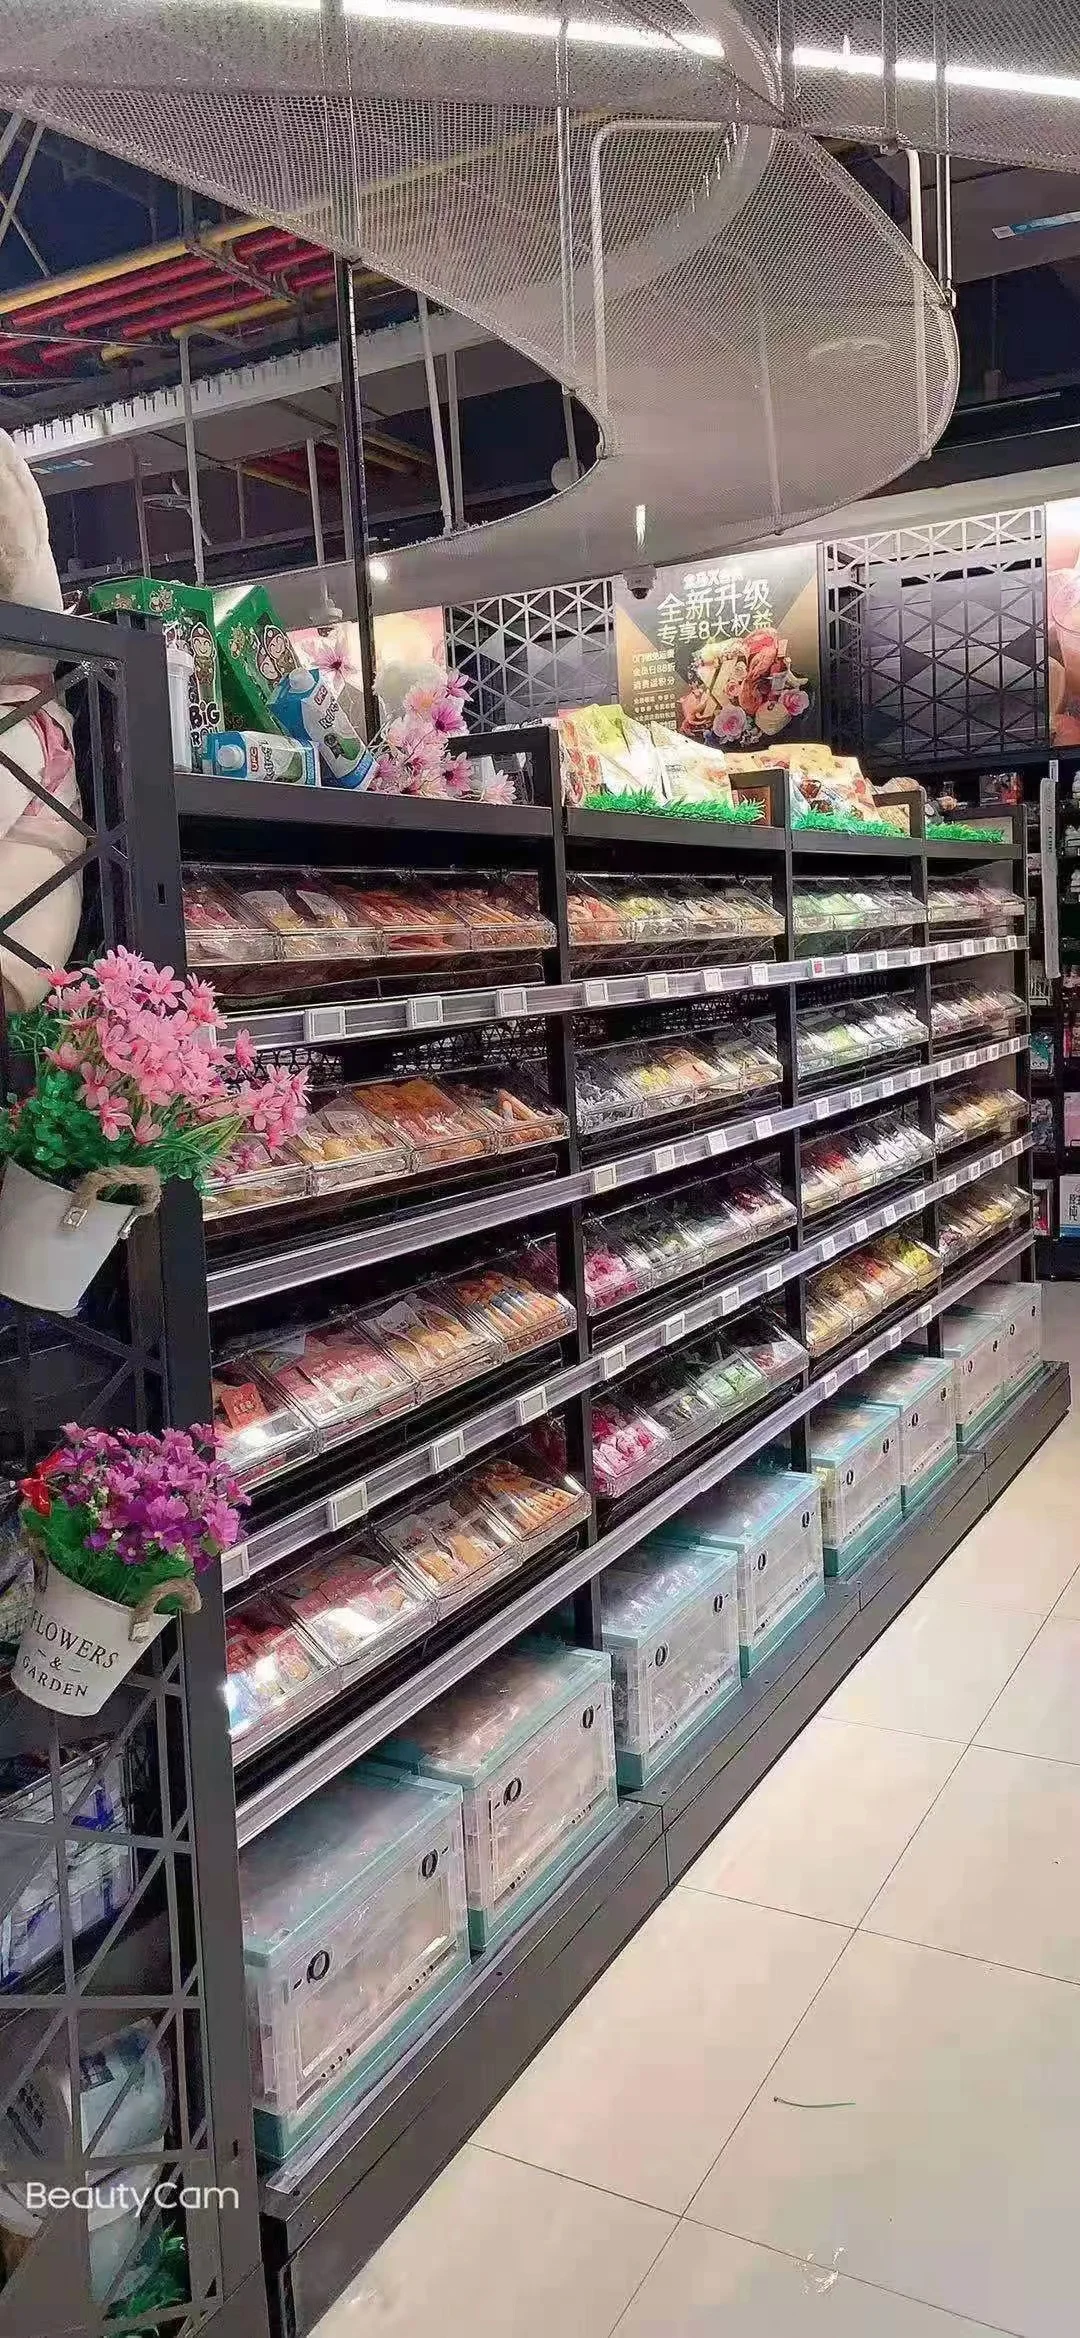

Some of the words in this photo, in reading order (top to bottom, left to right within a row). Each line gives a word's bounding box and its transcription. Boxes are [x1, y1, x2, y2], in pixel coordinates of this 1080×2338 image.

[657, 578, 773, 624] 全新升级
[656, 609, 774, 648] 专享8大权益
[31, 1610, 119, 1669] FLOWERS
[23, 1656, 89, 1697] GARDEN
